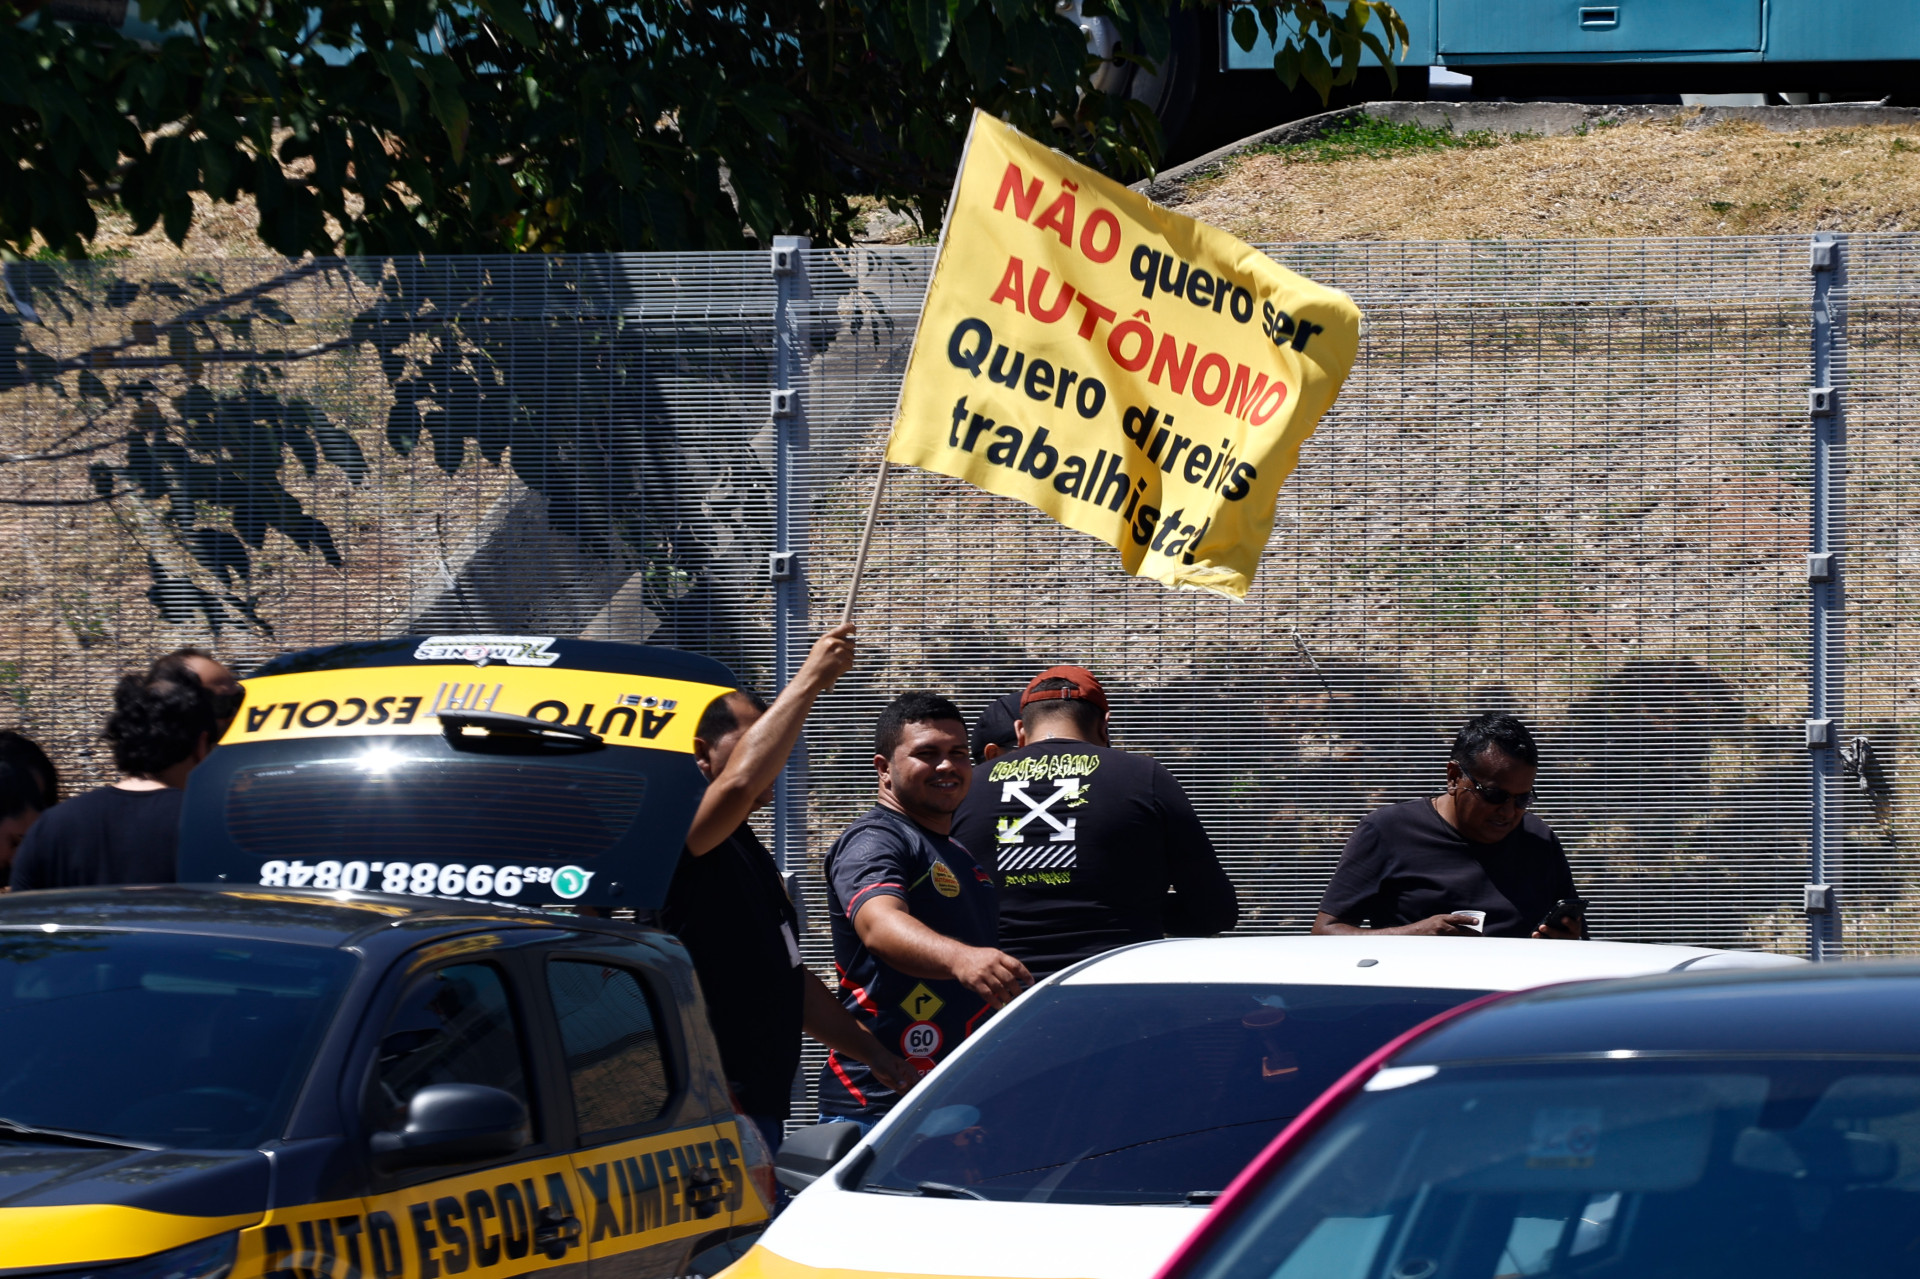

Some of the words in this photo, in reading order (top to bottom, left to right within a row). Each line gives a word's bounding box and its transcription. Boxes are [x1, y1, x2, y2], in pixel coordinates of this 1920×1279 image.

[994, 163, 1121, 264] NÃO
[1130, 244, 1253, 324] quero
[1262, 298, 1325, 354] ser
[990, 255, 1288, 426] AUTÔNOMO
[947, 317, 1107, 420] Quero
[1122, 405, 1257, 502] direis
[245, 696, 423, 733] ESCOLA
[422, 682, 503, 717] FIAT
[527, 699, 677, 740] AUTO
[910, 1029, 933, 1047] 60
[264, 1209, 404, 1279] AUTO
[408, 1172, 581, 1279] ESCOLA
[577, 1137, 744, 1243] XIMENES
